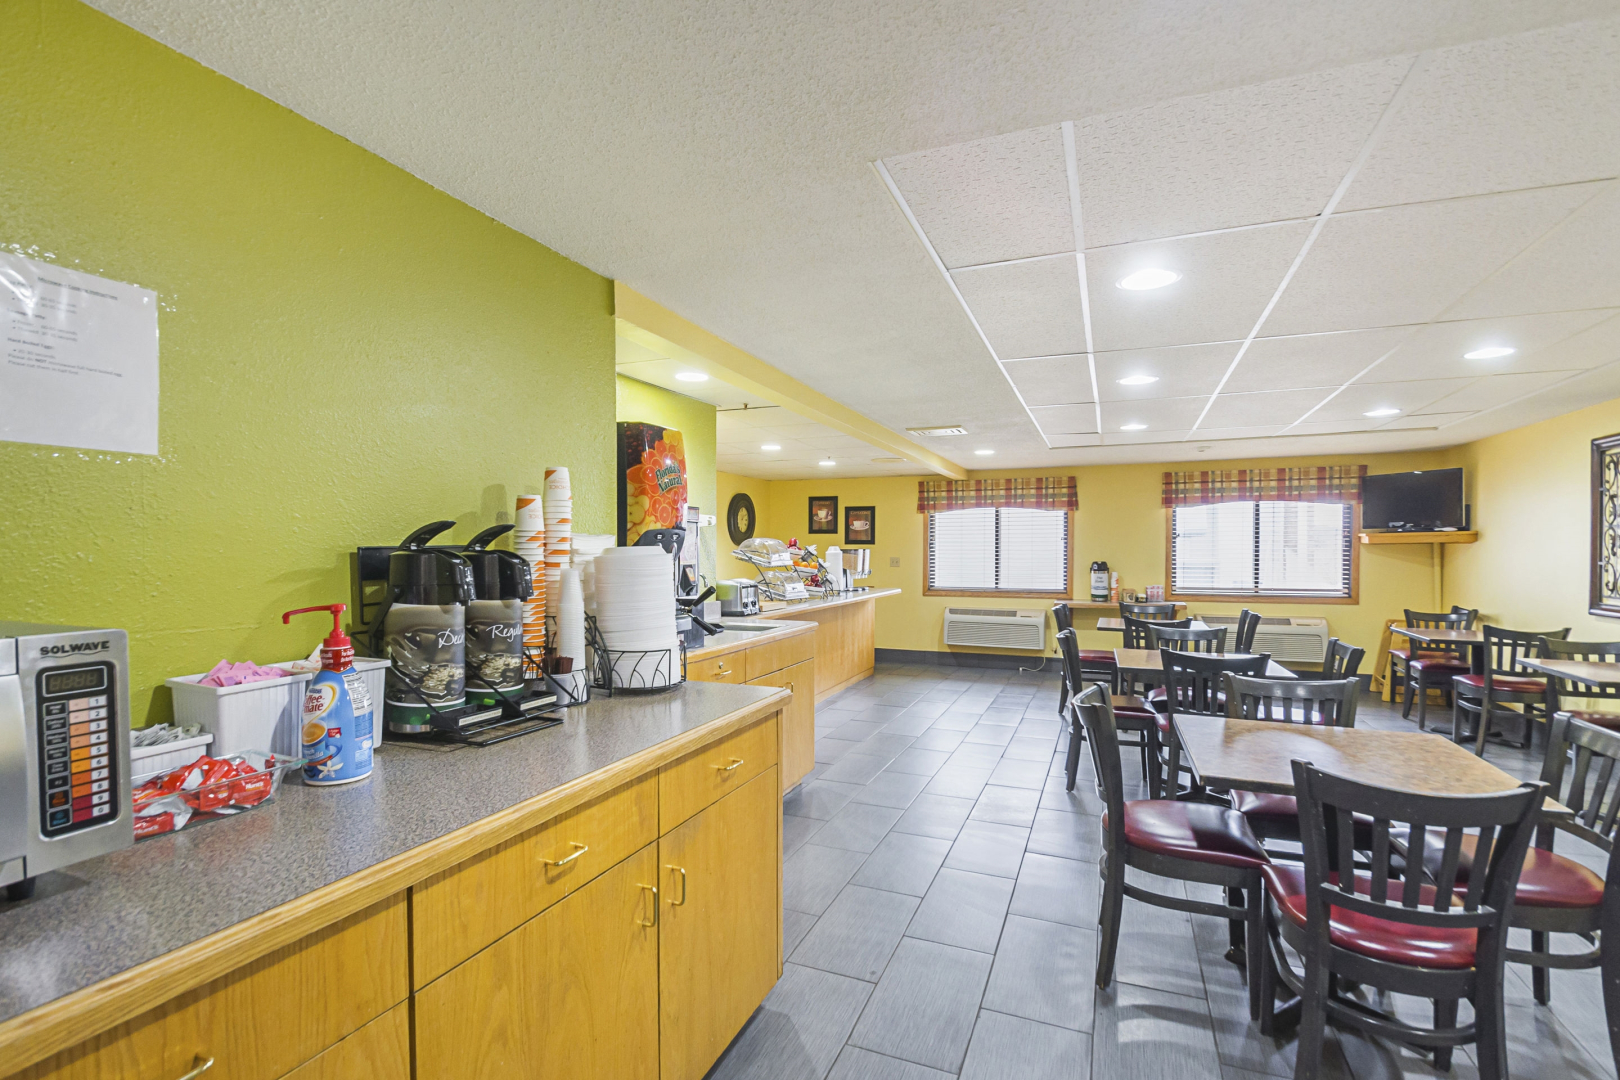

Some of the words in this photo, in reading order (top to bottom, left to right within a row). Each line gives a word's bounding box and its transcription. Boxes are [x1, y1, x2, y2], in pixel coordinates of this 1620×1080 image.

[658, 475, 683, 492] Natural
[437, 628, 465, 649] Deca
[486, 624, 523, 643] Regul
[40, 640, 110, 656] SOLWAVE
